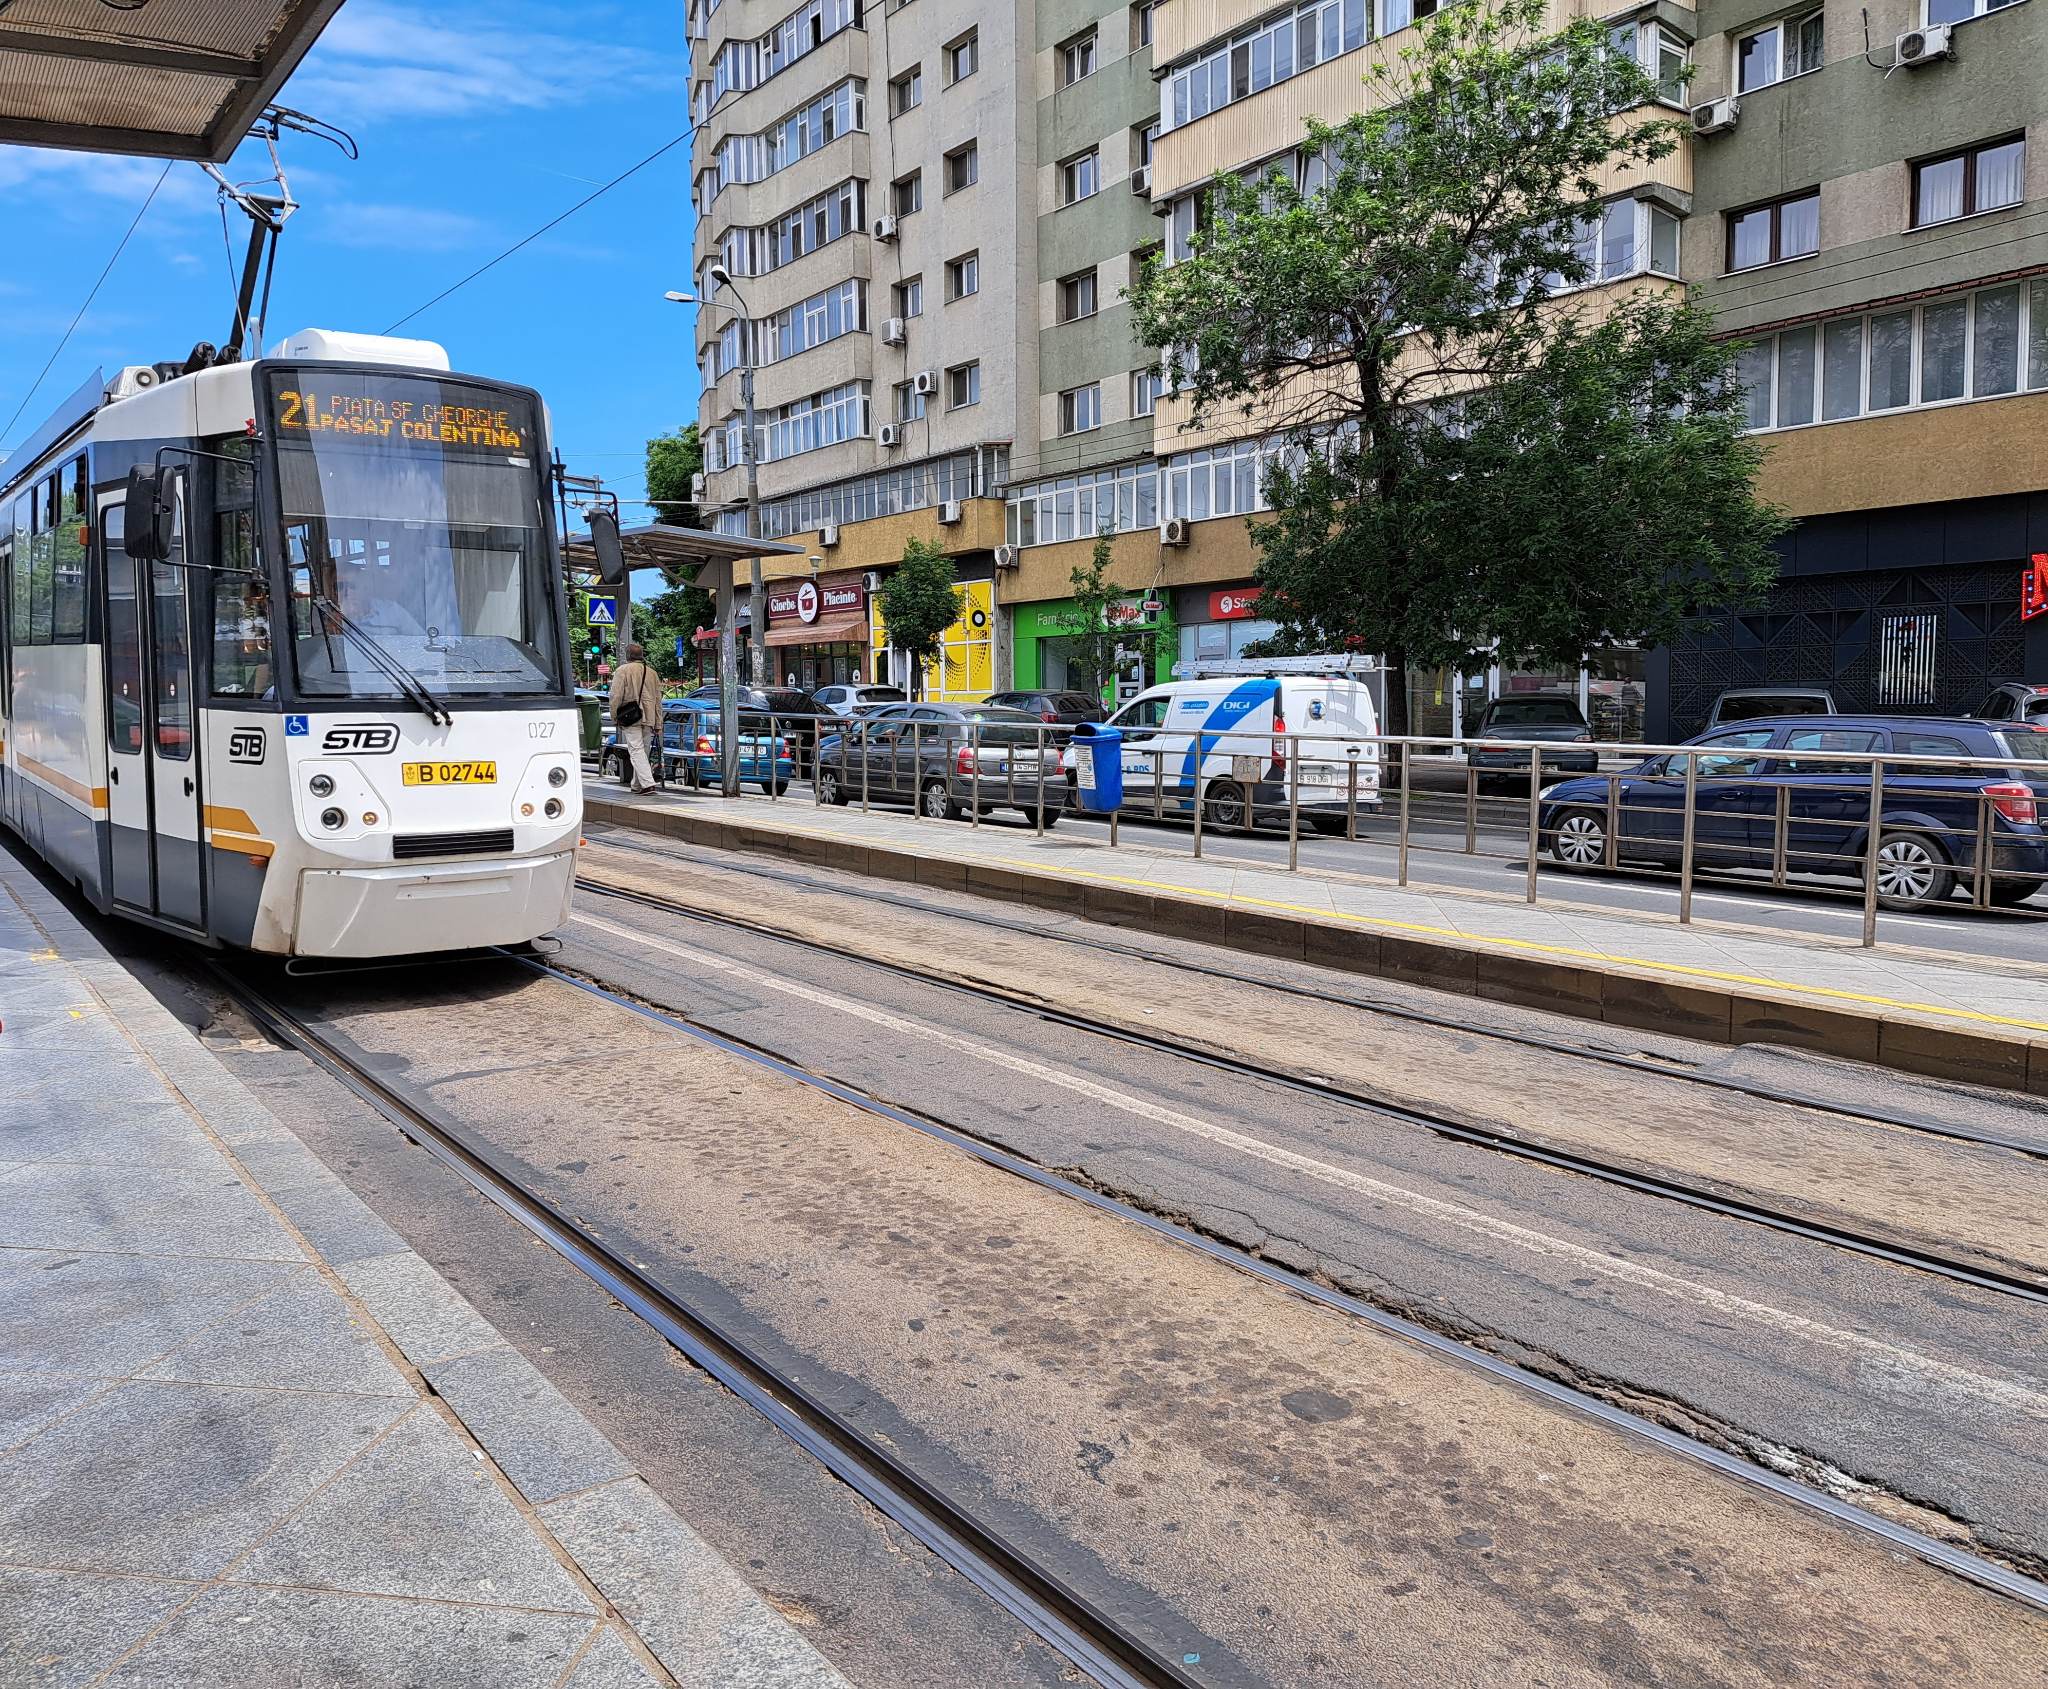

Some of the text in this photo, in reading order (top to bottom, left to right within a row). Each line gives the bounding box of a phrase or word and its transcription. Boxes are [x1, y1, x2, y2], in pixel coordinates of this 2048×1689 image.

[279, 391, 320, 430] 21
[331, 395, 385, 417] PIATA
[422, 404, 510, 429] GHEORGHE
[320, 412, 521, 448] PASAJ COLENTINA
[1223, 701, 1250, 710] DIGI
[322, 729, 393, 750] STB
[528, 722, 556, 739] 027
[230, 733, 264, 757] STB
[420, 763, 495, 782] B 02744
